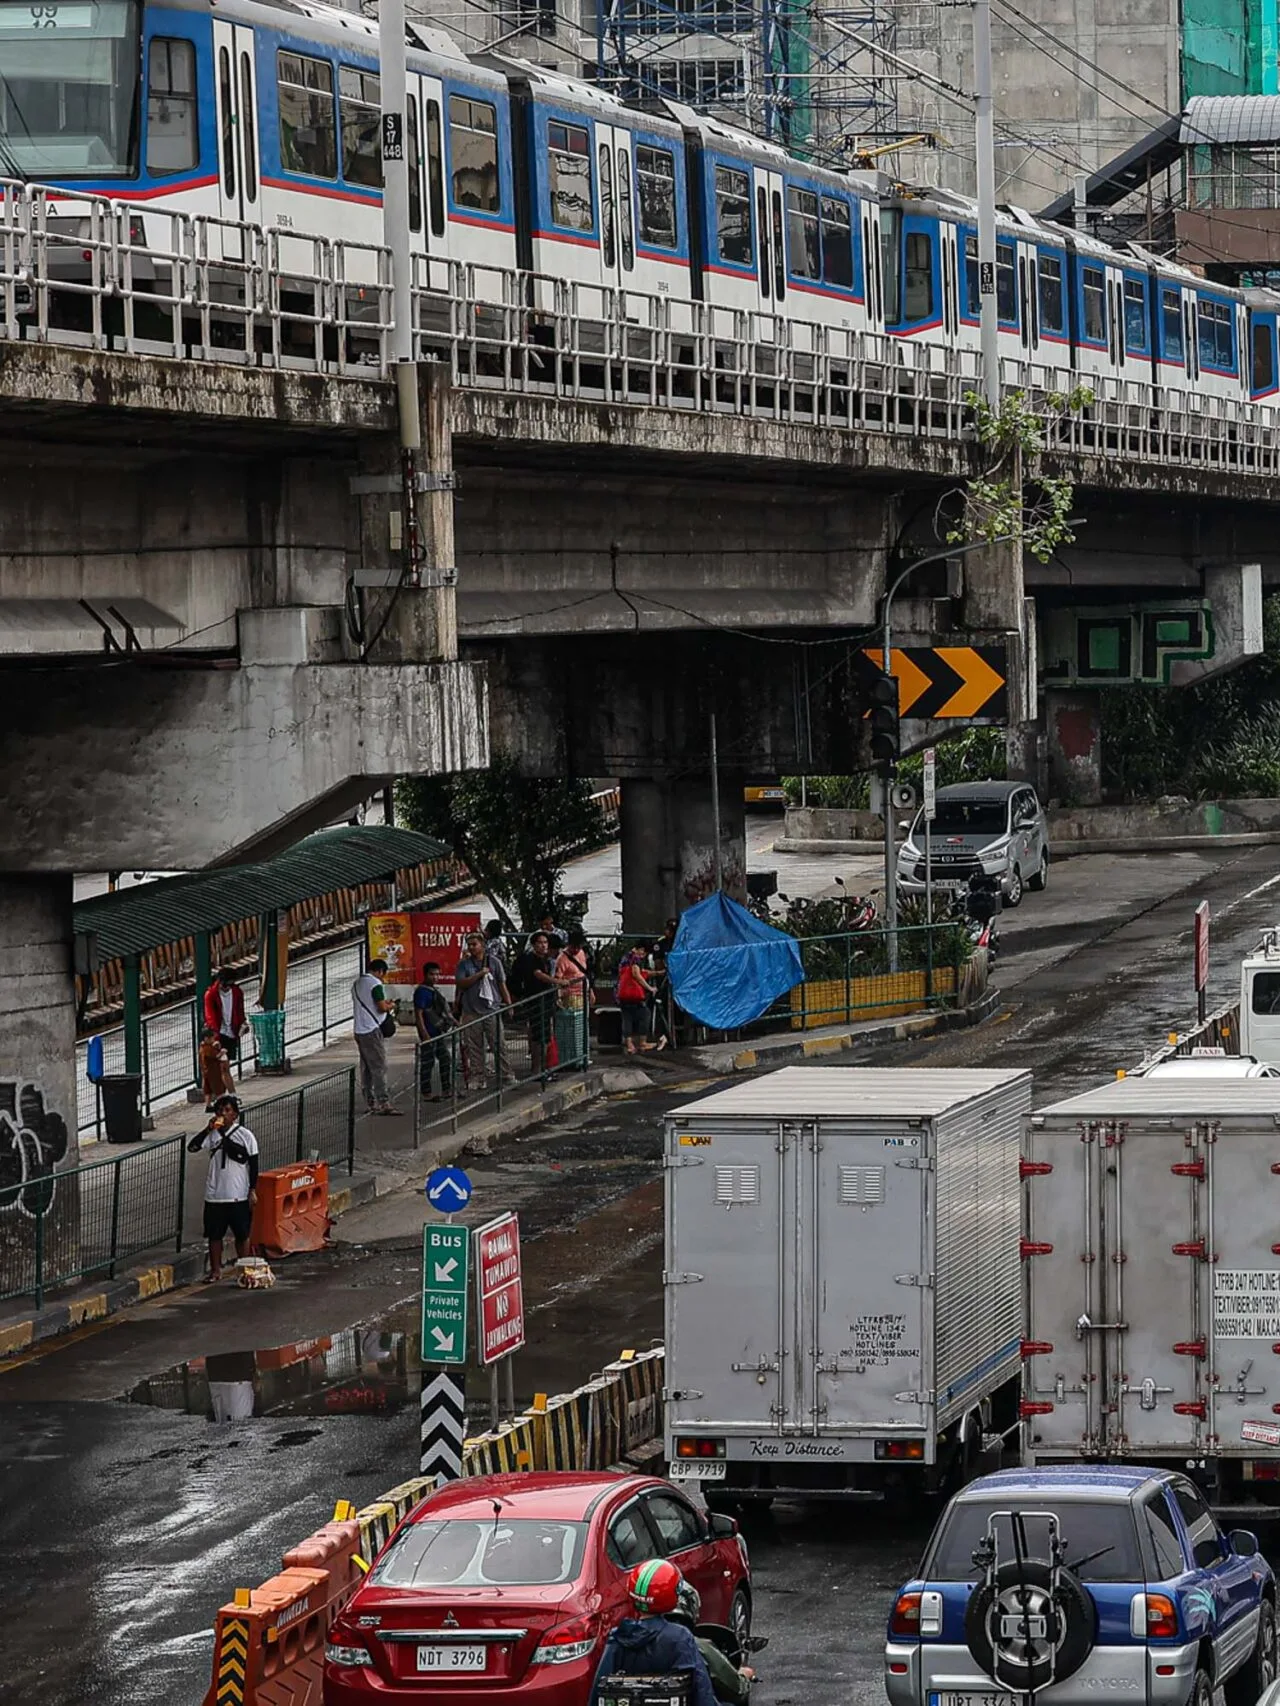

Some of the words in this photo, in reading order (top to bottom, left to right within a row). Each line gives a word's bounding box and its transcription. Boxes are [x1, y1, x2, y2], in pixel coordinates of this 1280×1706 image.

[387, 116, 394, 129] S
[386, 130, 396, 144] 17
[430, 925, 455, 933] TIBAY
[417, 933, 452, 948] TIBAY
[431, 1234, 462, 1248] Bus
[488, 1231, 512, 1260] BAWAL
[486, 1254, 518, 1288] TUMAWID
[1215, 1272, 1234, 1291] LTFRB
[1236, 1272, 1248, 1291] 24/7
[430, 1296, 460, 1306] Private
[496, 1290, 508, 1320] NO
[427, 1309, 462, 1320] Vehicles
[487, 1315, 520, 1352] JAYWALKING
[850, 1324, 882, 1332] HOTLINE
[886, 1324, 906, 1332] 1342
[750, 1440, 778, 1456] Keep
[671, 1464, 691, 1476] CBP
[698, 1464, 725, 1476] 9719
[276, 1597, 309, 1628] MMDA
[419, 1651, 442, 1665] NDT
[452, 1651, 484, 1665] 3796
[1078, 1678, 1140, 1690] TOYOTA
